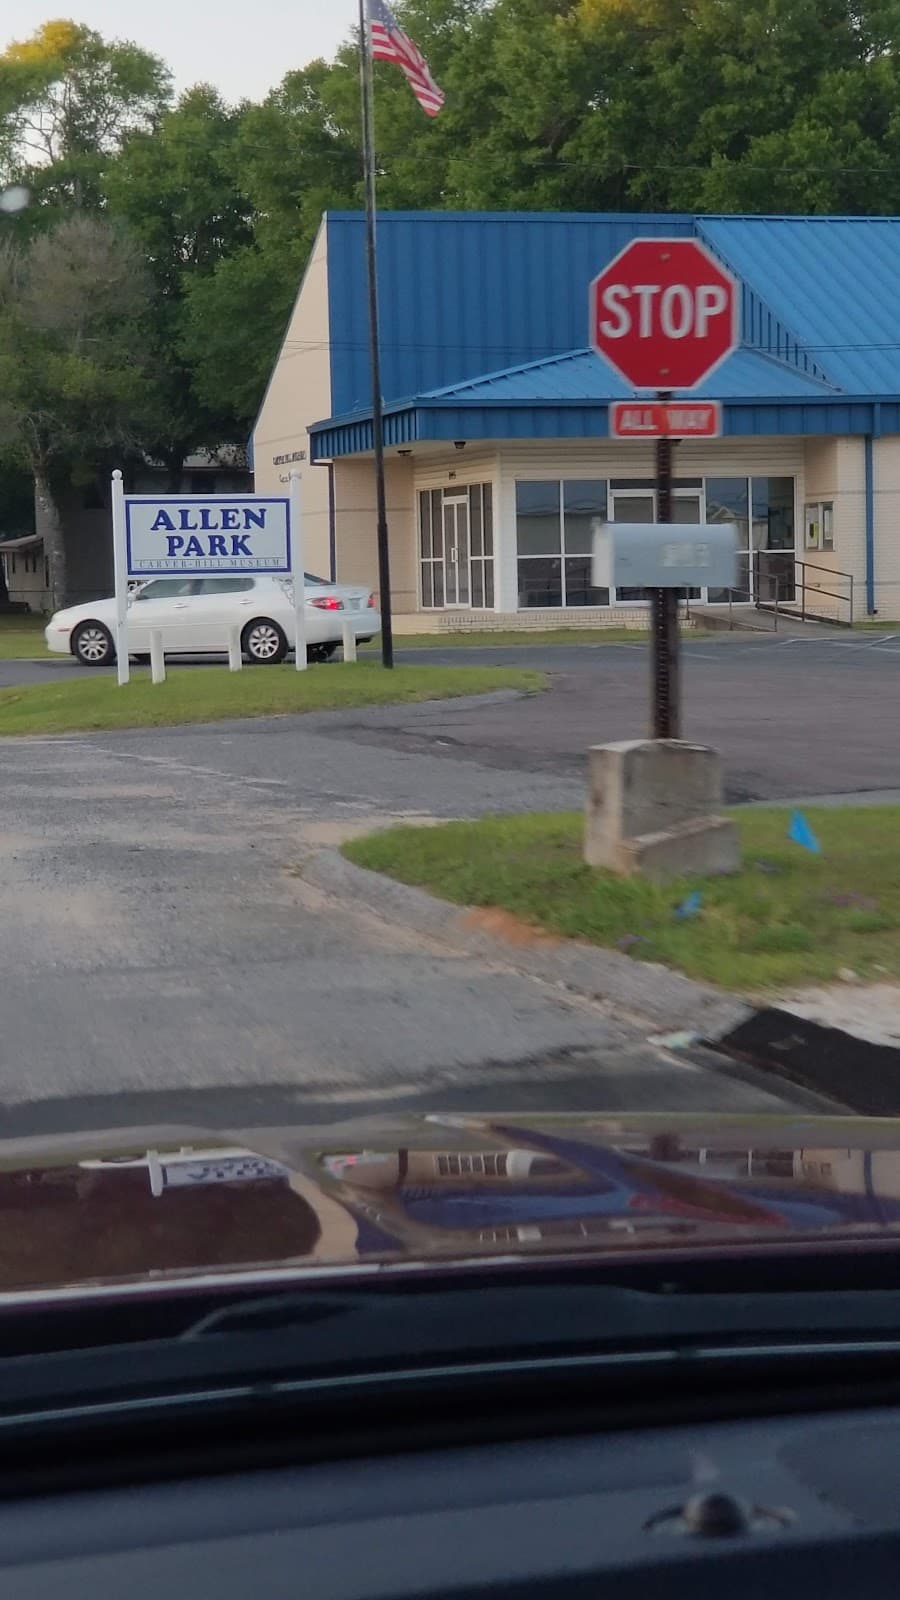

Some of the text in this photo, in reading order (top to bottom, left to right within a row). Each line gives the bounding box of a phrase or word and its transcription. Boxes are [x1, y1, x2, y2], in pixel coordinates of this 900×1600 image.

[600, 284, 728, 339] STOP
[619, 409, 713, 430] ALL WAY
[150, 508, 267, 531] ALLEN
[166, 534, 253, 557] PARK
[230, 558, 280, 567] MUSEUM
